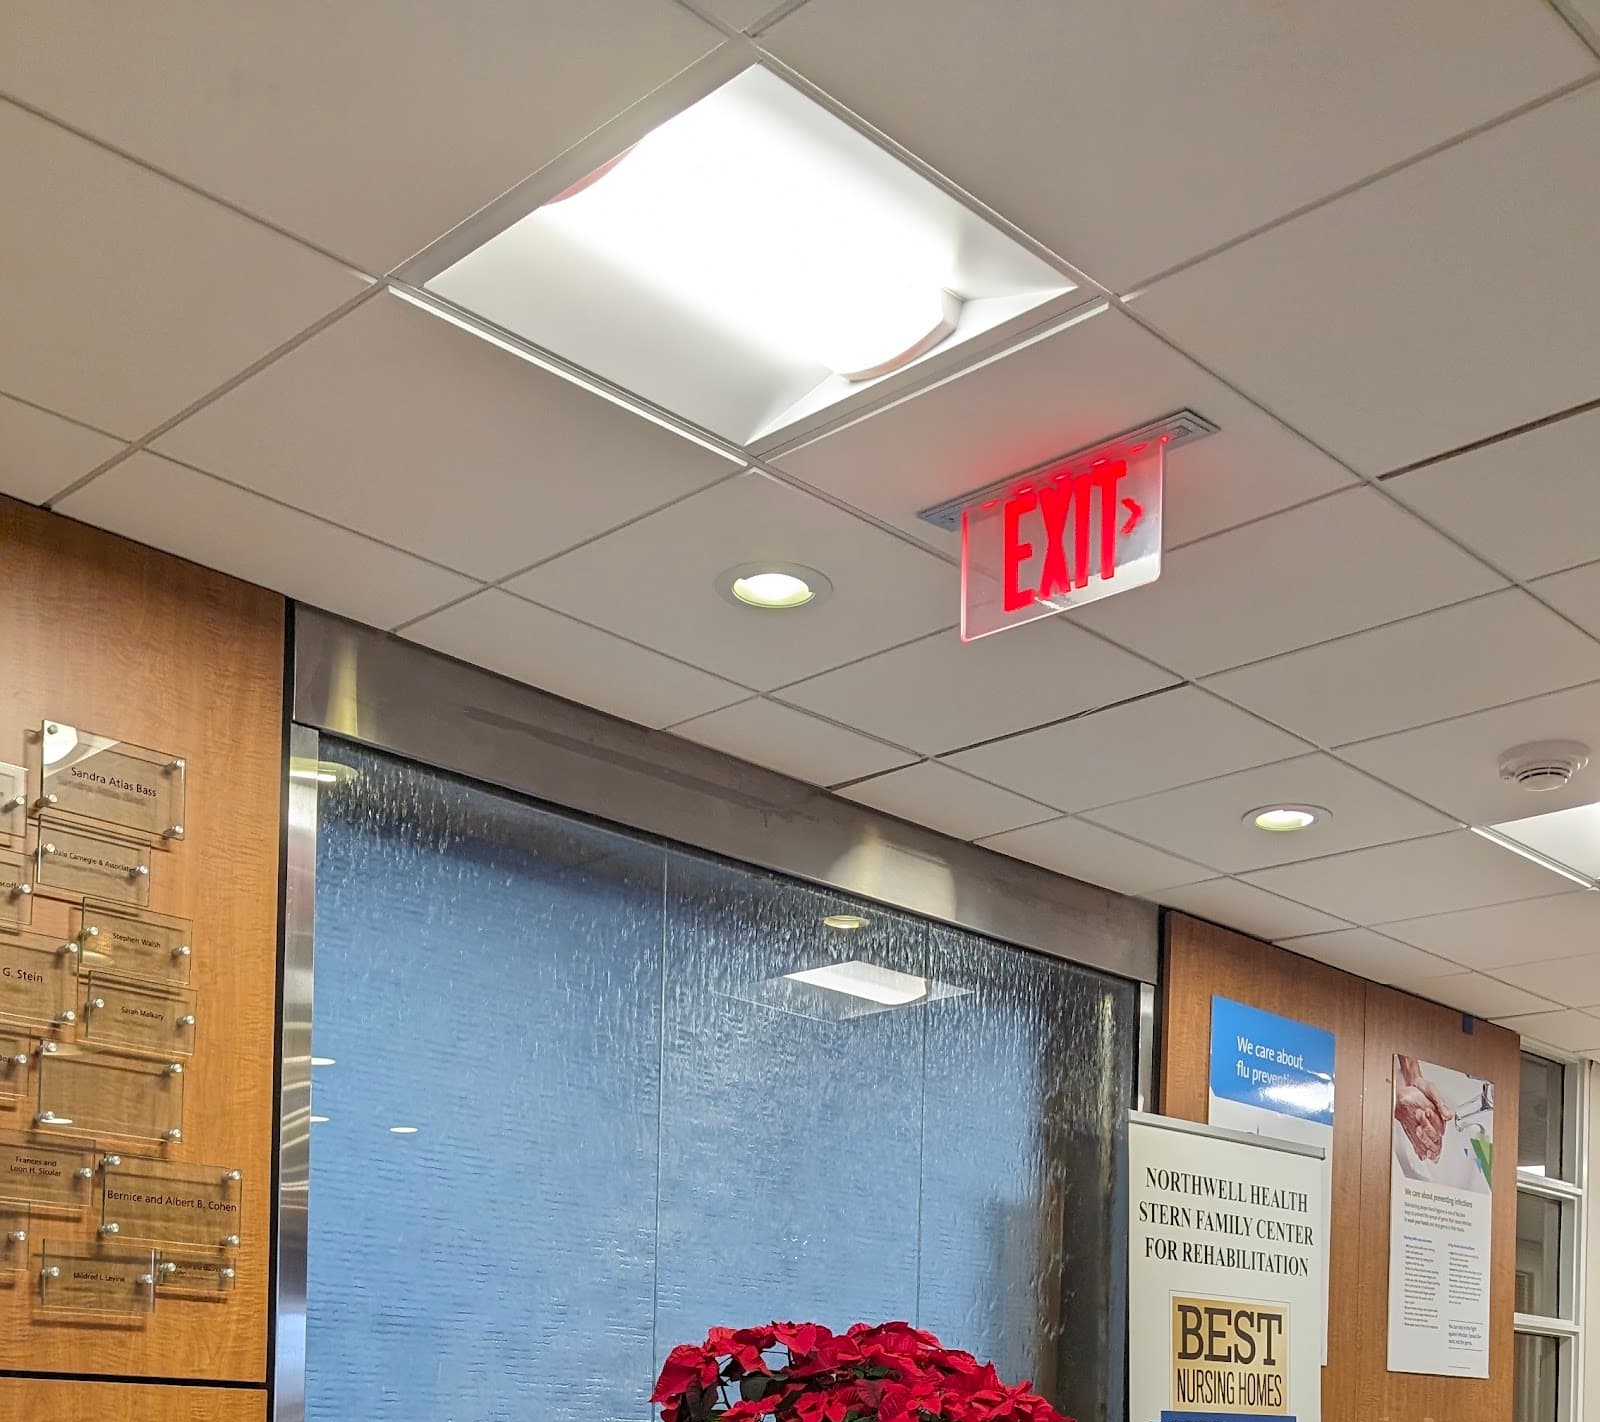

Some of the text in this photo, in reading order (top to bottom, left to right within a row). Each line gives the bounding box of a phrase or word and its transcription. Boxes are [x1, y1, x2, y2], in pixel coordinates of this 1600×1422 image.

[1003, 459, 1127, 612] EXIT
[71, 767, 157, 797] Sandra Atlas Bass
[69, 852, 97, 865] Carnegie
[112, 932, 140, 945] Stephen
[2, 967, 43, 983] G. Stein
[121, 1006, 139, 1015] Sarah
[1237, 1036, 1303, 1070] We care about
[1236, 1060, 1249, 1079] flu
[16, 1156, 57, 1167] Frances and
[107, 1190, 237, 1212] Bernice and Albert B. Cohen
[1146, 1167, 1308, 1213] NORTHWELL HEALTH
[1139, 1201, 1314, 1246] STERN FAMILY CENTER
[1145, 1237, 1309, 1277] FOR REHABILITATION
[1177, 1304, 1282, 1366] BEST
[1177, 1368, 1282, 1407] NURSING HOMES
